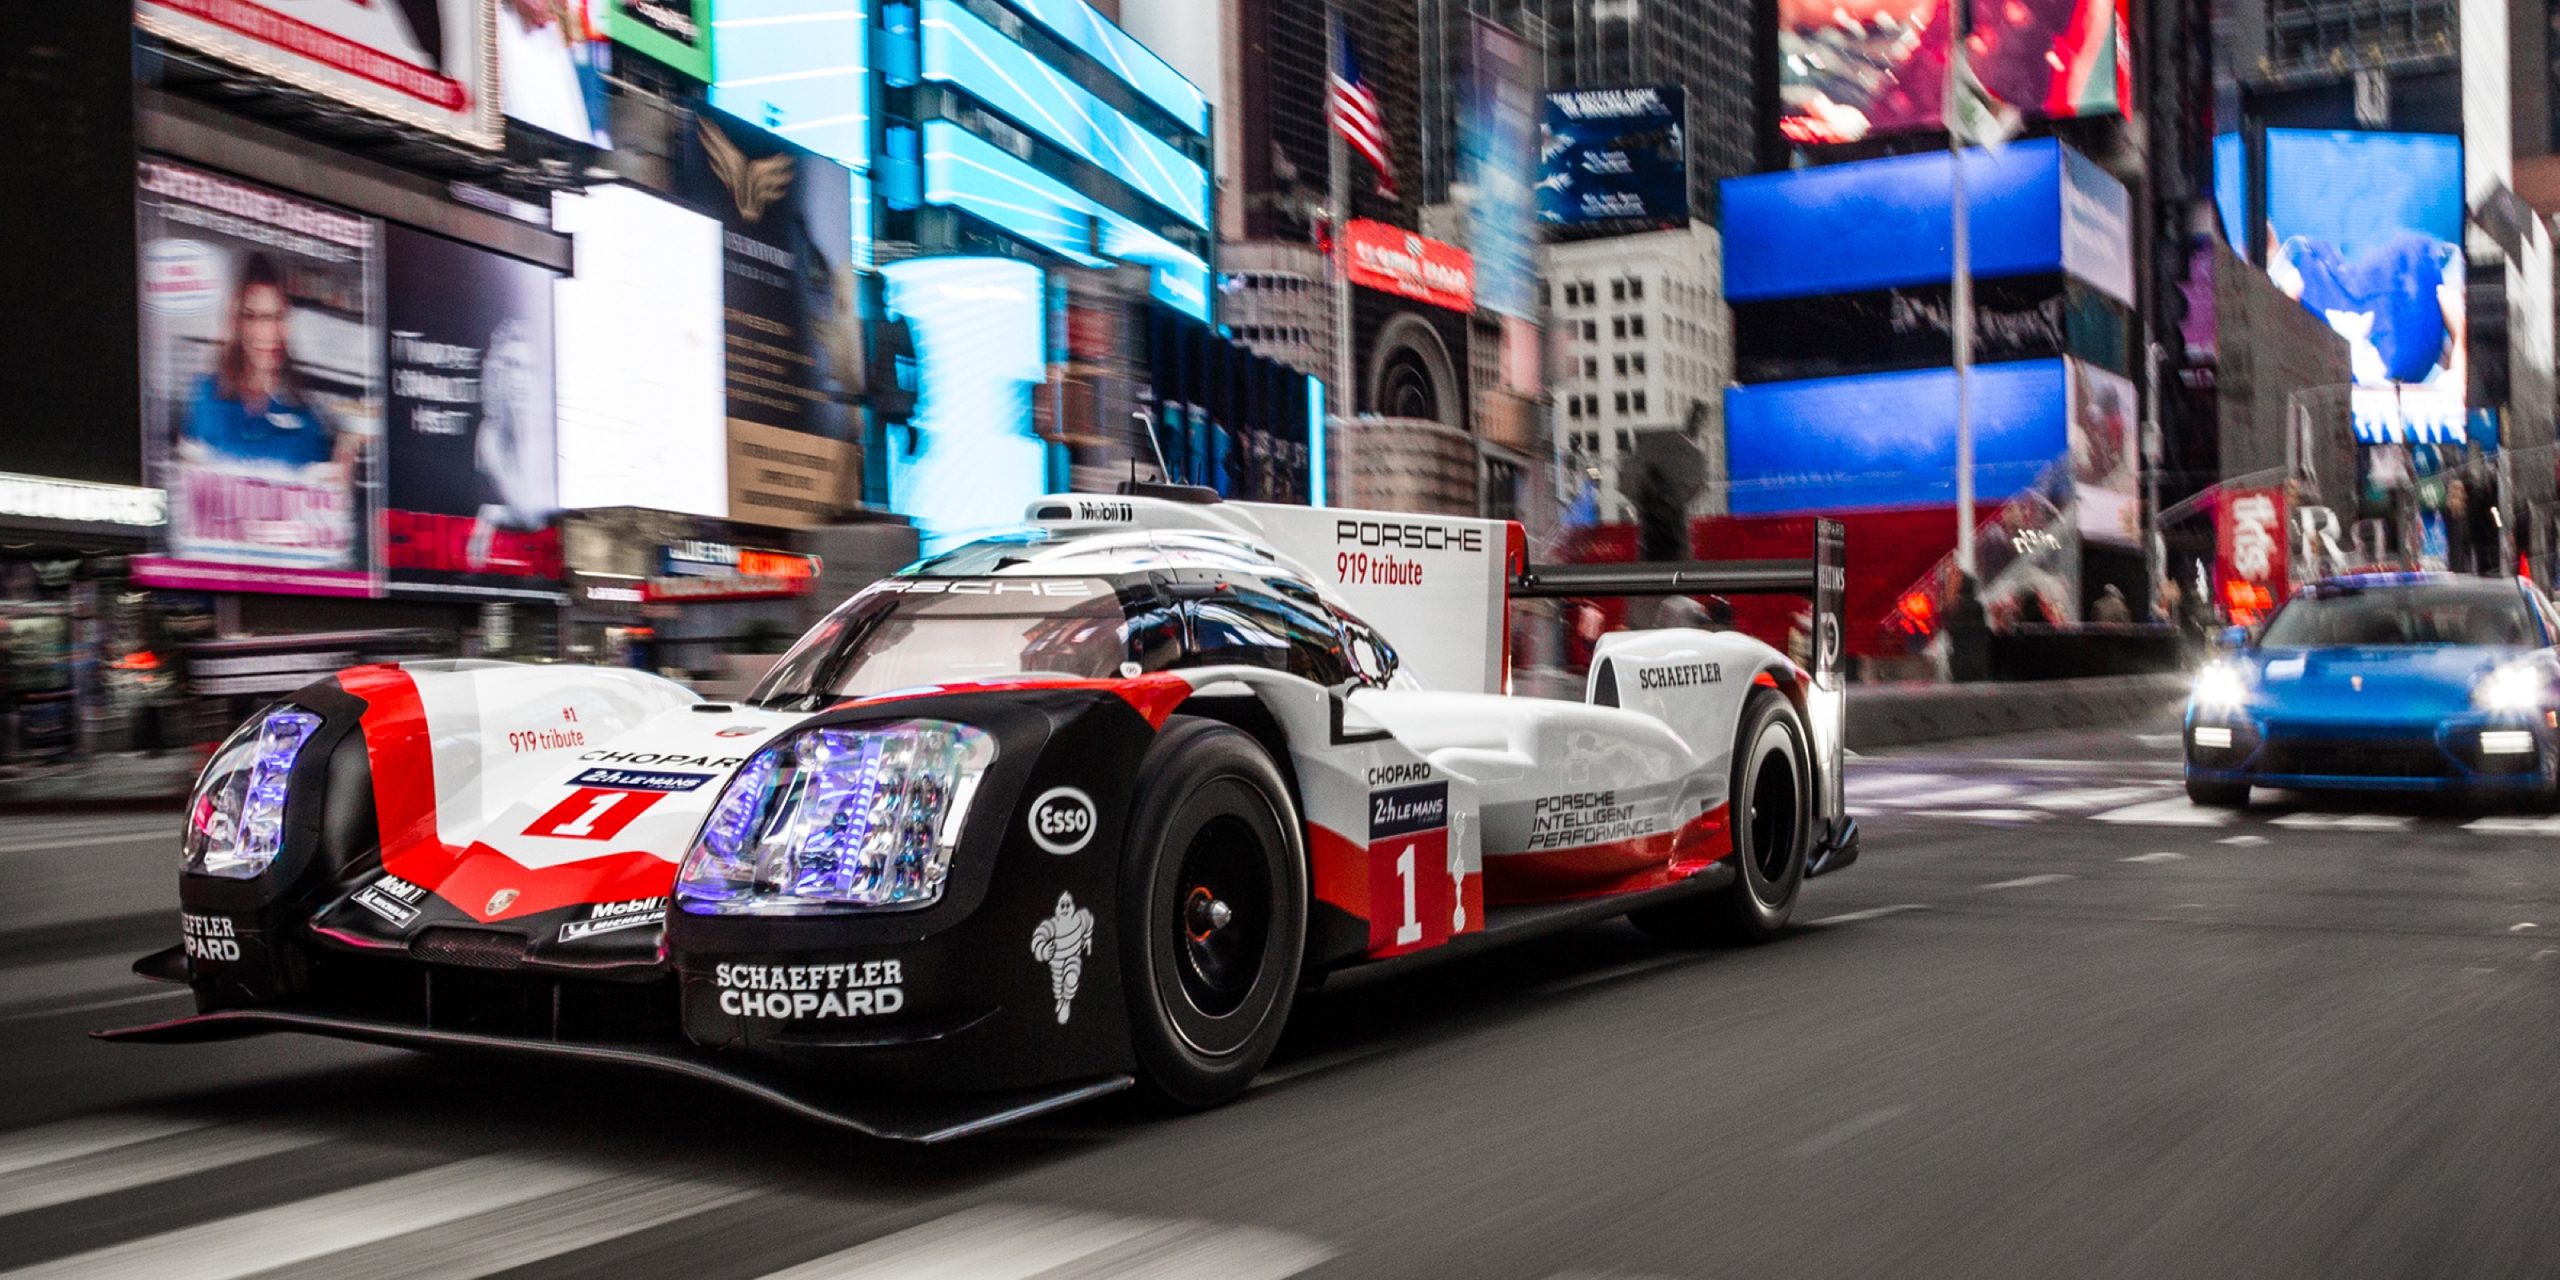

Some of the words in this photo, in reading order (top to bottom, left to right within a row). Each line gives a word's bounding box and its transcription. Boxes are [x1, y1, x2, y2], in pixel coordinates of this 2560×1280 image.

[1079, 501, 1118, 521] Mobil
[1337, 520, 1482, 552] PORSCHE
[1337, 551, 1368, 584] 919
[1371, 554, 1423, 586] tribute
[1639, 662, 1722, 690] SCHAEFFLER
[562, 706, 578, 722] #1
[508, 730, 537, 753] 919
[538, 728, 585, 750] tribute
[577, 751, 746, 769] CHOPAR
[1368, 762, 1431, 786] CHOPARD
[552, 792, 628, 837] 1
[1397, 803, 1411, 820] LE
[1411, 798, 1444, 818] MANS
[1535, 790, 1615, 814] PORSCHE
[1532, 804, 1635, 833] INTELLIGENT
[1527, 818, 1654, 851] PERFORMANCE
[591, 896, 658, 919] Mobil
[1396, 843, 1423, 947] 1
[181, 913, 235, 937] EFFLER
[716, 959, 904, 991] SCHAEFFLER
[719, 987, 904, 1019] CHOPARD
